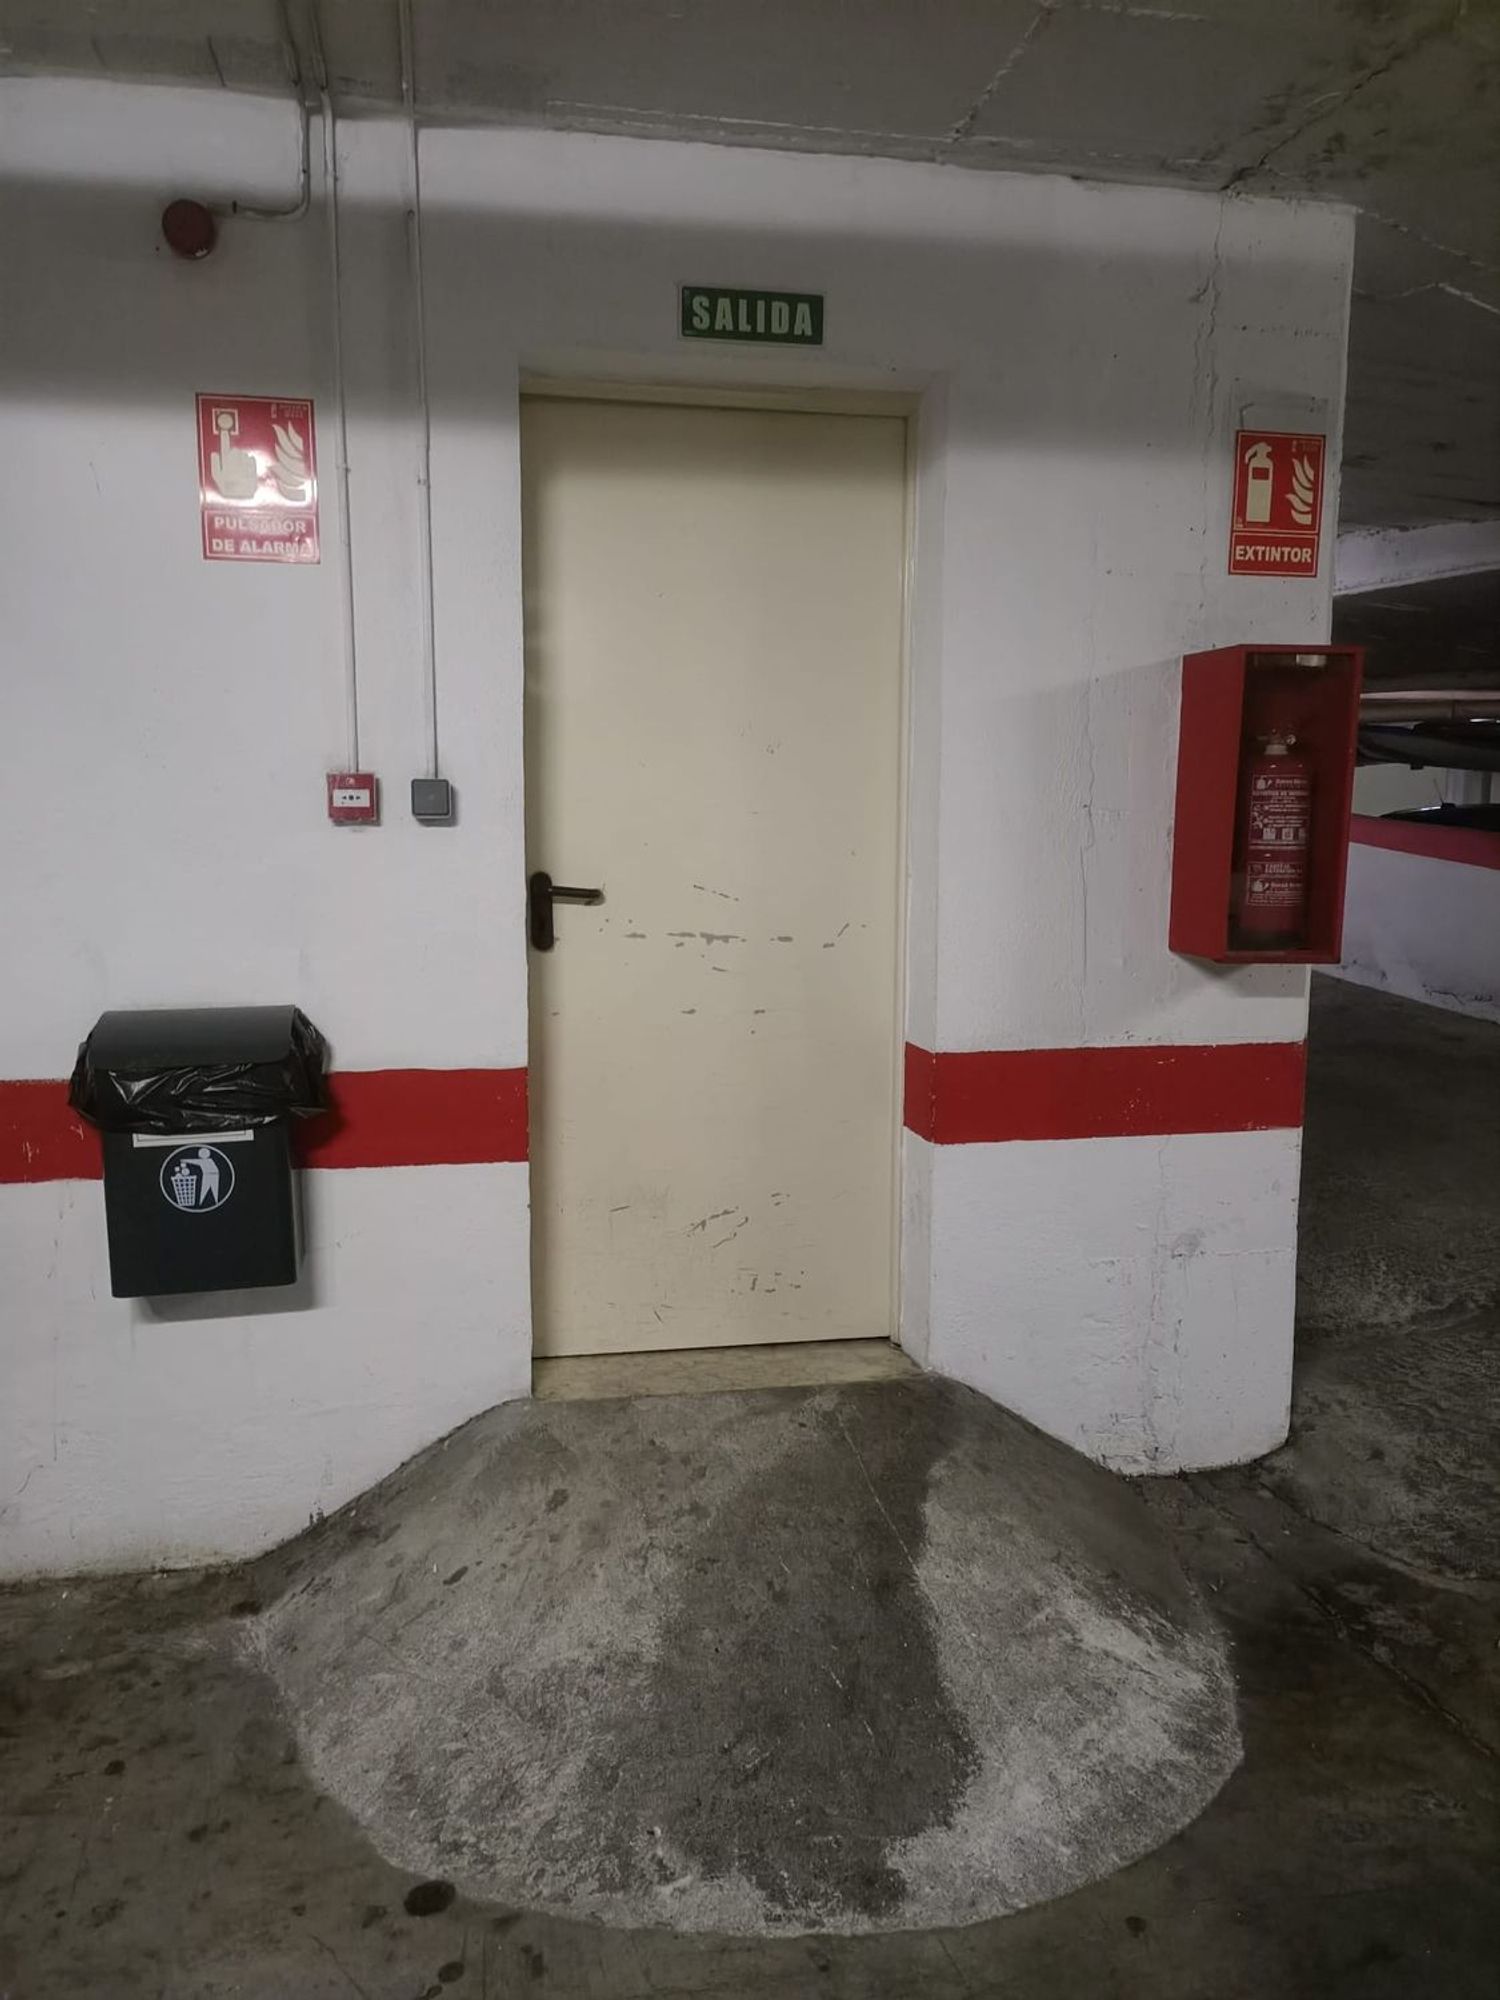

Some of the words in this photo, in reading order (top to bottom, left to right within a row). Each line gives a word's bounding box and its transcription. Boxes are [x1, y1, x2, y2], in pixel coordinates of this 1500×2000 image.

[691, 295, 813, 337] SALIDA
[213, 516, 307, 534] PULSADOR
[211, 538, 235, 552] DE
[239, 538, 314, 557] ALARMA
[1234, 545, 1312, 563] EXTINTOR
